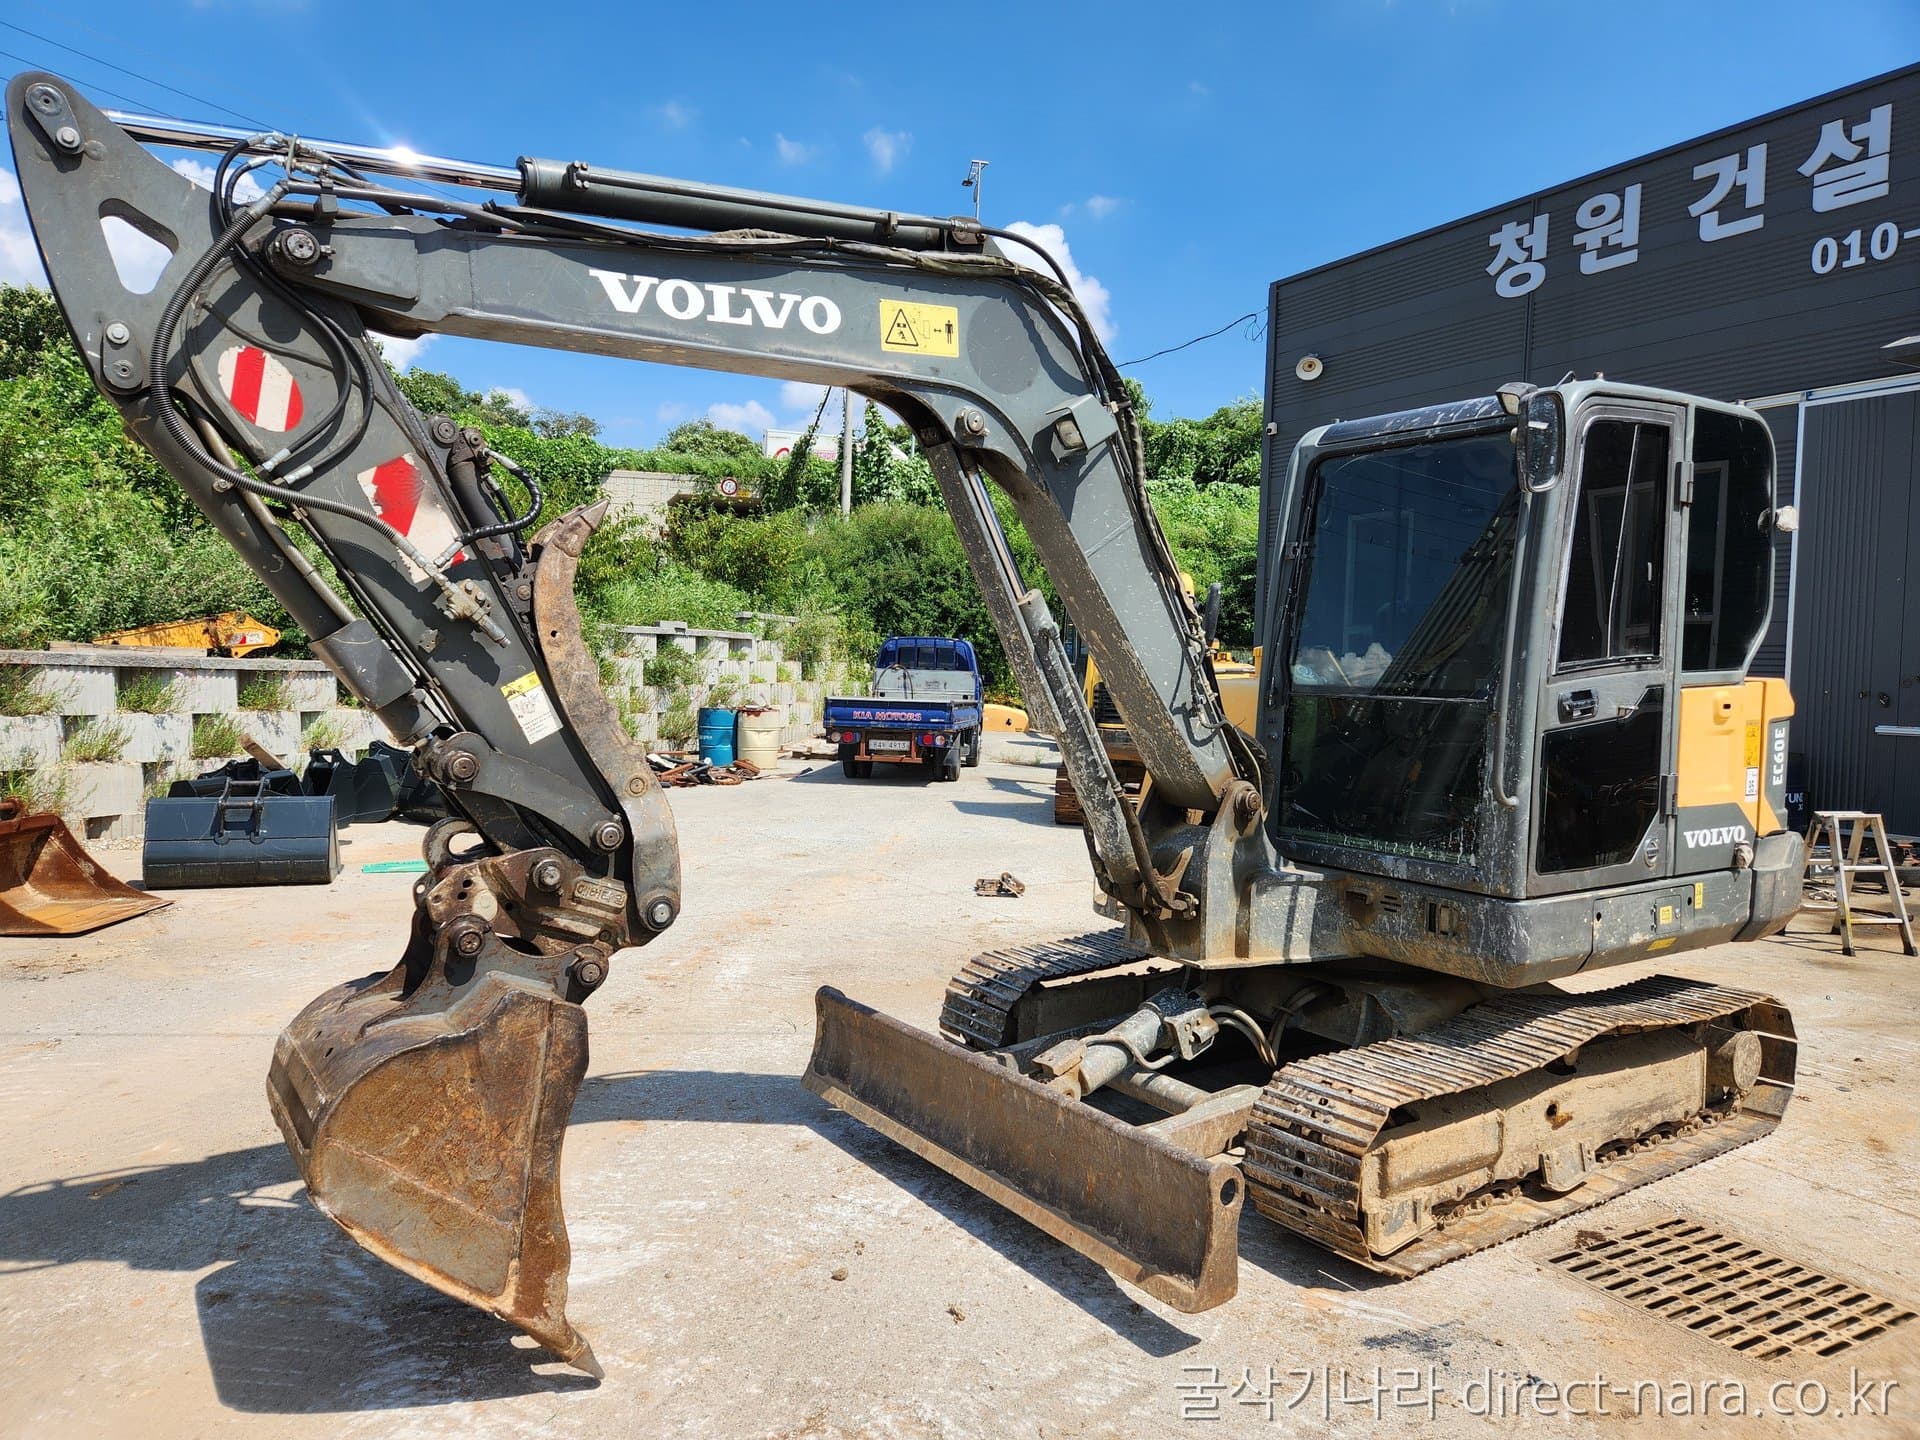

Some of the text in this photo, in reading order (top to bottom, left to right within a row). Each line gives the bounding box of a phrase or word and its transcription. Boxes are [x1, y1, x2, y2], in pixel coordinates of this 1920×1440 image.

[1485, 103, 1893, 298] 청원 건설
[589, 269, 842, 335] VOLVO
[853, 710, 922, 721] KIA MOTORS
[1772, 727, 1786, 786] EC60E
[1683, 825, 1746, 849] VOLVO
